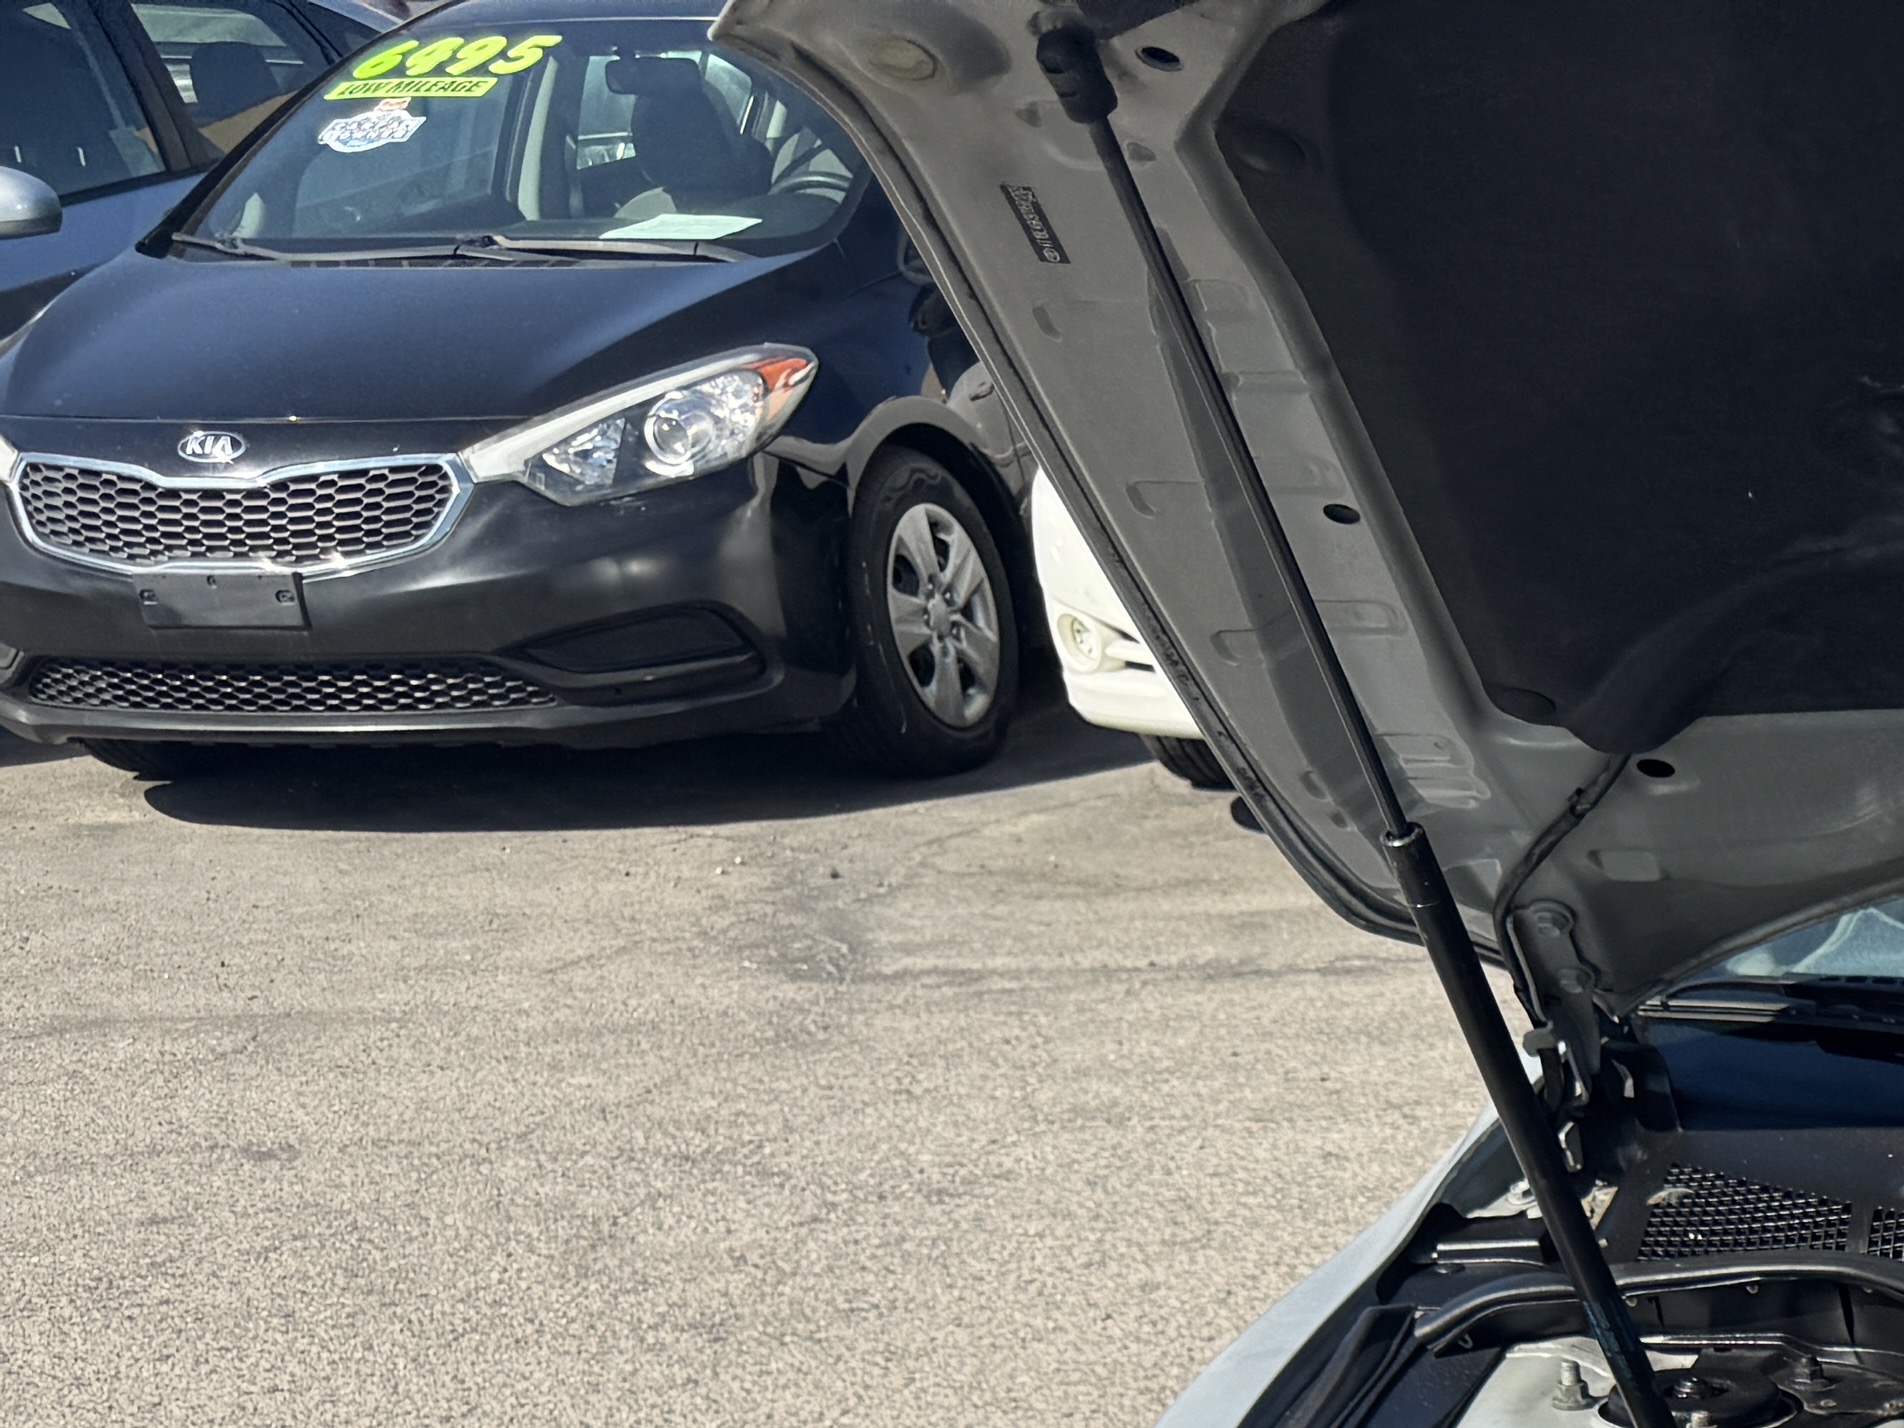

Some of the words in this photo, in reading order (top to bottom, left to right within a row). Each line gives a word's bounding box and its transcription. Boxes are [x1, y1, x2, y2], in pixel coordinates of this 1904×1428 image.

[353, 35, 562, 79] 6495
[338, 81, 392, 96] LOW
[386, 80, 489, 94] MILEAGE
[185, 435, 233, 455] KIA
